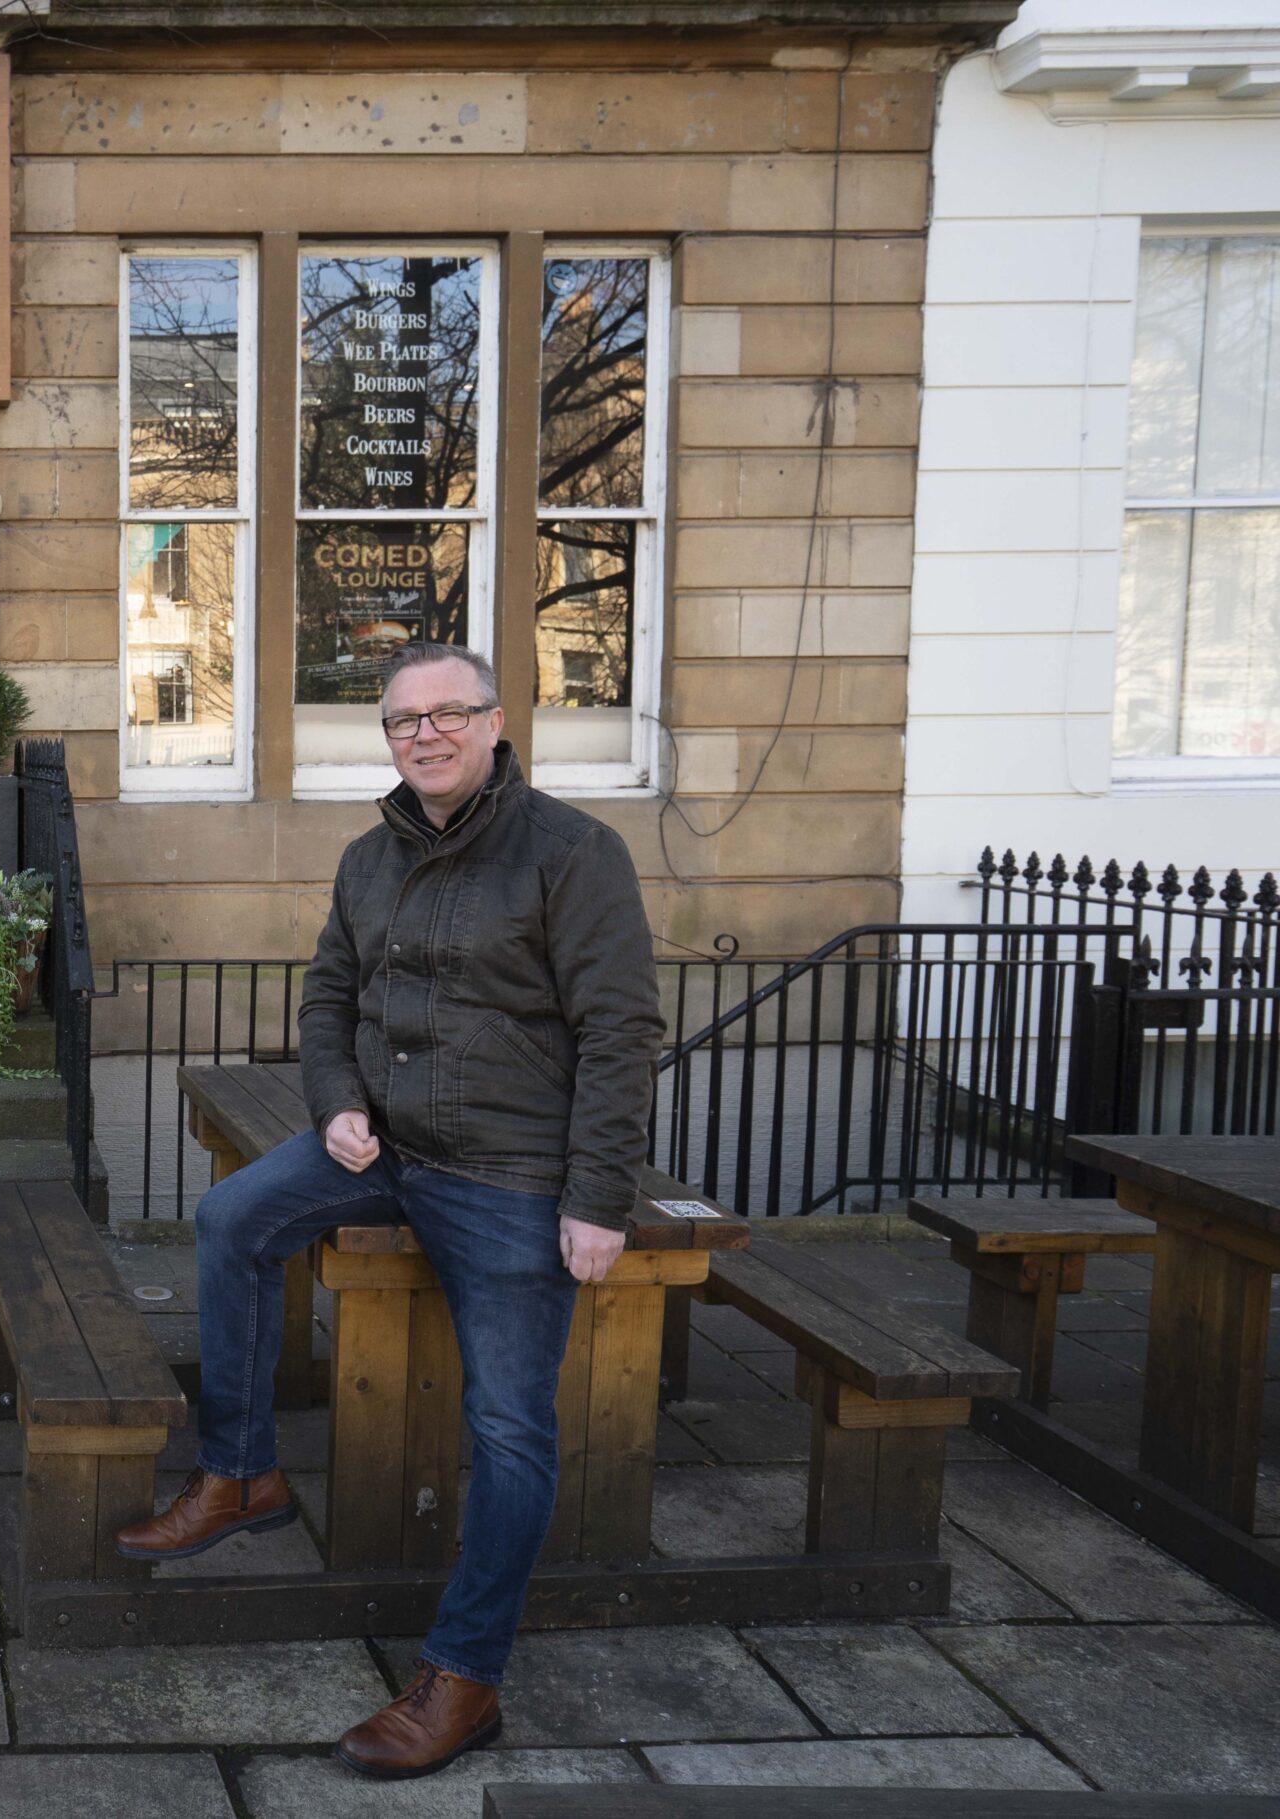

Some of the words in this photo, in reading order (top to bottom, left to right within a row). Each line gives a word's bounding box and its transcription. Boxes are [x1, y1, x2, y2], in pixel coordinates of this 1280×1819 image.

[367, 278, 416, 297] WINGS
[354, 309, 427, 330] BURGERS
[342, 341, 375, 361] WEE
[379, 341, 439, 361] PLATES
[353, 373, 427, 392] BOURBON
[363, 404, 416, 424] BEERS
[346, 435, 432, 455] COCKTAILS
[363, 467, 414, 487] WINES
[337, 572, 427, 588] LOUNGE
